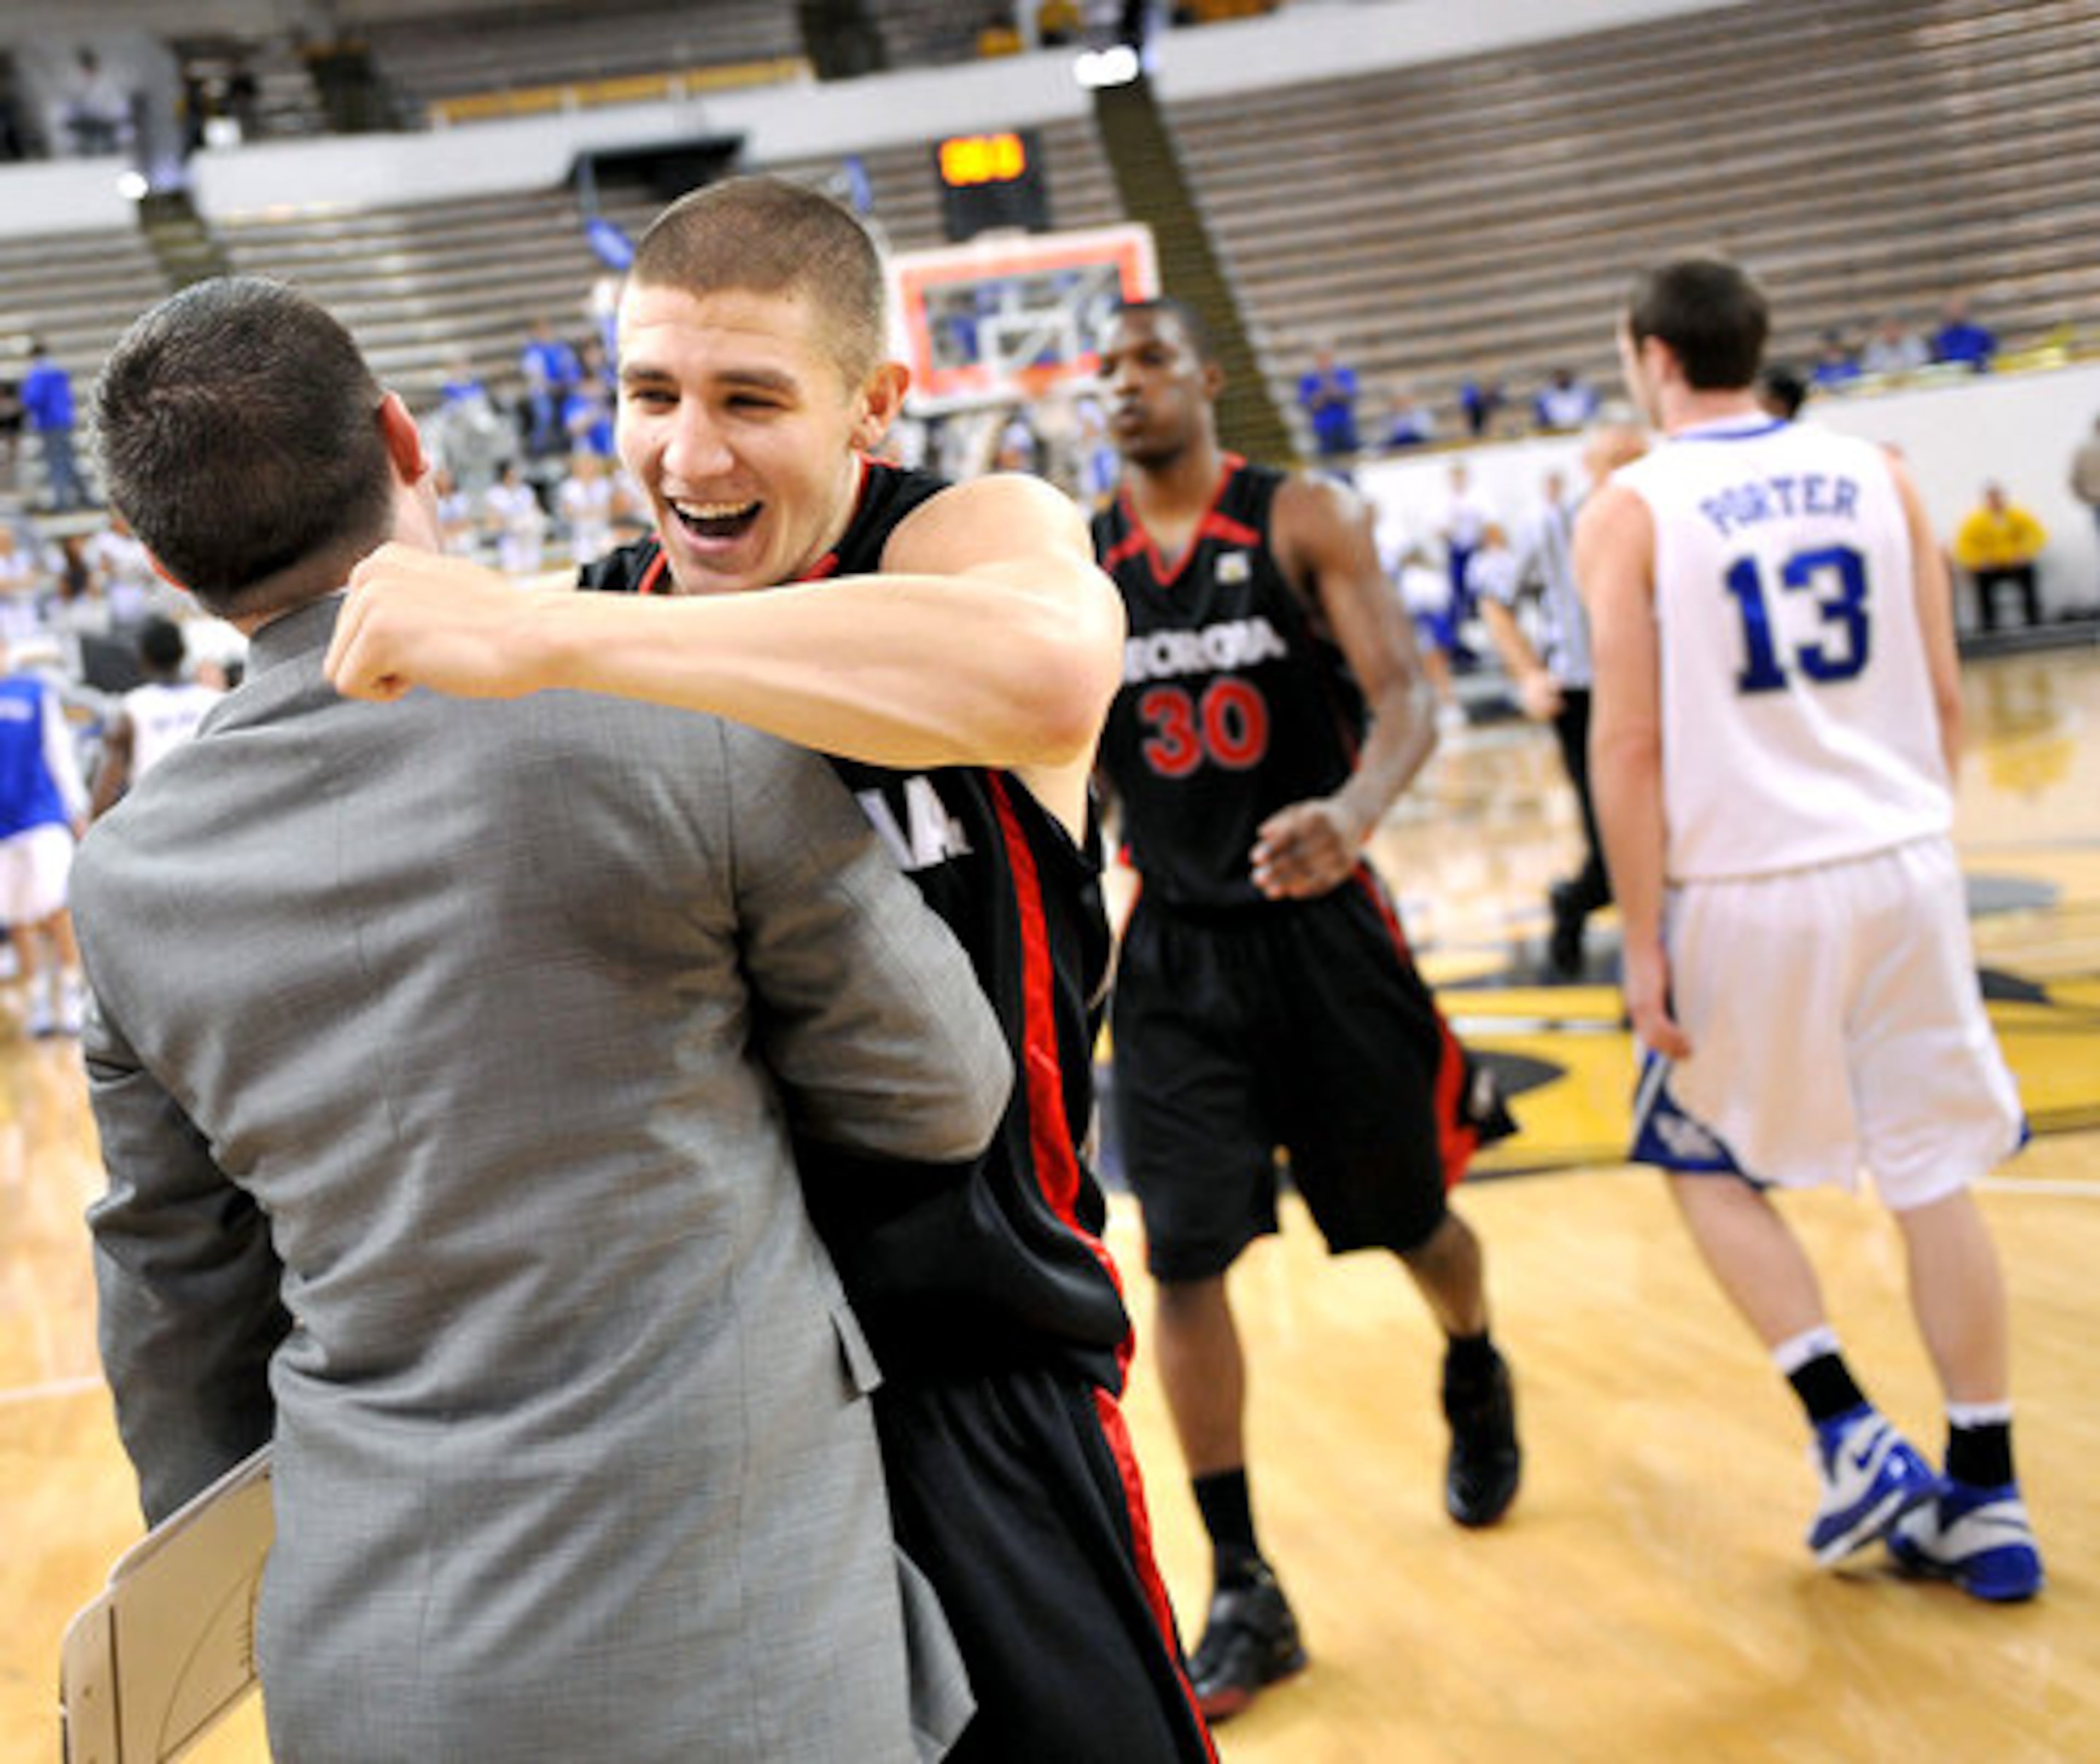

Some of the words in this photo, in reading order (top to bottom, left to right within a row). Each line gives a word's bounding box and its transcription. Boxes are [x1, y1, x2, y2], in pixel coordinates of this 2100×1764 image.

[1699, 474, 1860, 538] PORTER
[1123, 615, 1287, 682] EORGIA
[1723, 544, 1870, 693] 13
[1140, 677, 1268, 776] 30
